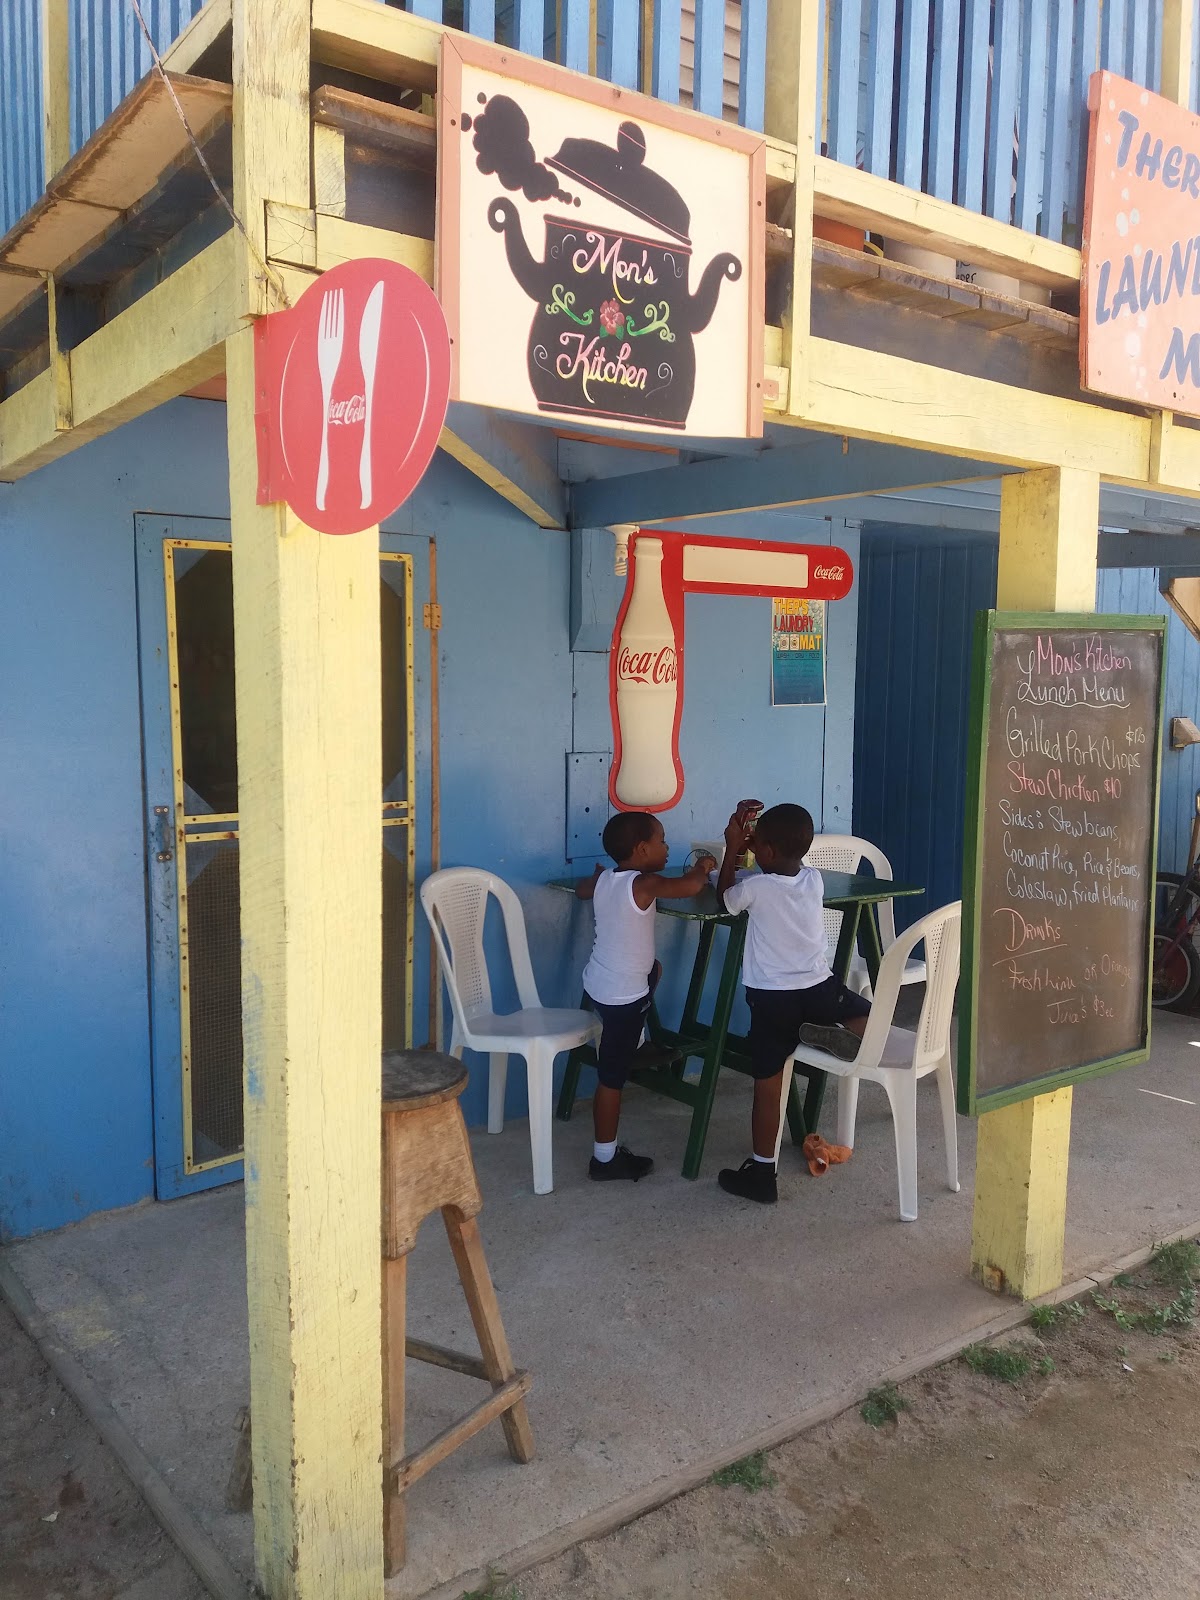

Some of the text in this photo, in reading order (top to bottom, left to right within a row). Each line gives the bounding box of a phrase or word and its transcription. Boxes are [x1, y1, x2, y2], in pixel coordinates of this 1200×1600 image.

[1118, 110, 1200, 200] THER
[573, 231, 658, 304] Mon's
[556, 332, 648, 404] Kitchen
[814, 565, 845, 580] Coca-Cola
[774, 599, 808, 615] THER'S
[774, 615, 814, 632] LAUNDRY
[799, 634, 821, 650] MAT
[1086, 635, 1132, 673] Kitchen
[1017, 650, 1125, 704] Lunch Menu
[1006, 706, 1063, 763] Grilled
[1066, 729, 1101, 767] Pork
[1102, 735, 1141, 775] Chops
[1007, 761, 1121, 802] Stew Chicken $10
[999, 799, 1044, 830] Sides:
[1003, 830, 1050, 872] Coconut
[1083, 851, 1105, 876] Rice
[1106, 847, 1112, 881] &
[1102, 954, 1132, 987] Orange
